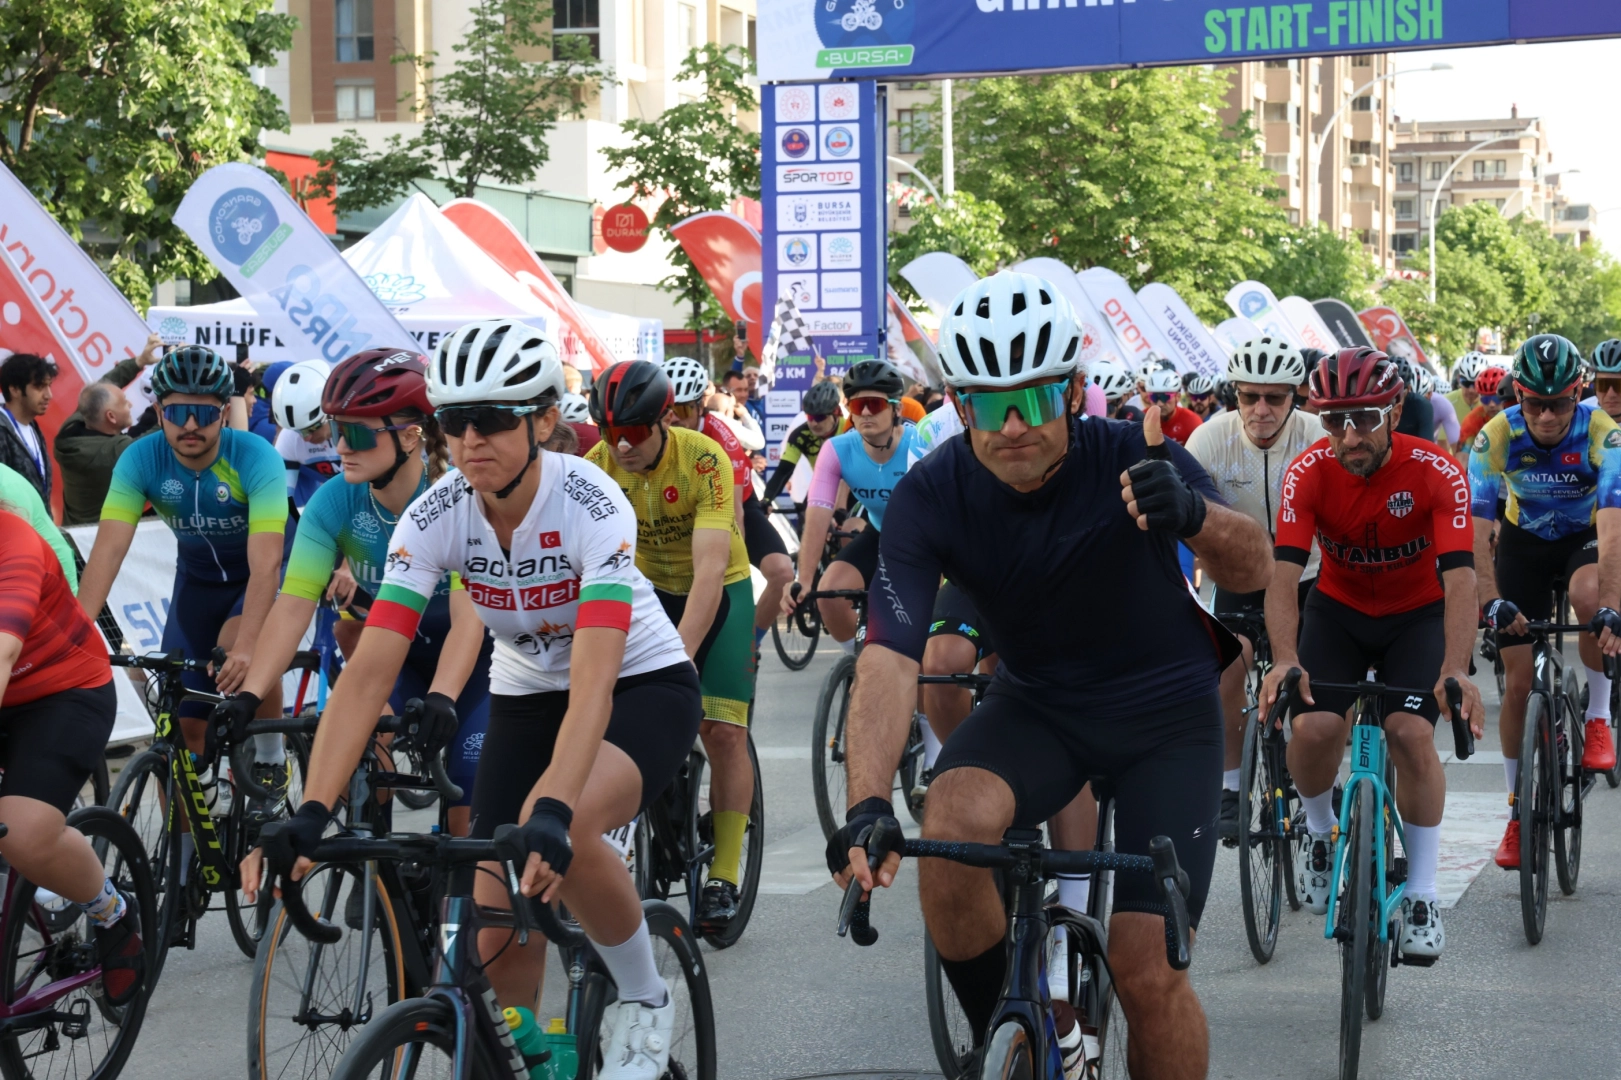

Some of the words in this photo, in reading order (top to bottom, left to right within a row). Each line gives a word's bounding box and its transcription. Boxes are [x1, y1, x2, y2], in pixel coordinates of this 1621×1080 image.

[1204, 0, 1443, 53] START-FINISH
[829, 50, 898, 65] BURSA
[373, 352, 412, 372] MET
[786, 367, 806, 379] KM
[567, 470, 619, 515] kadans
[1522, 473, 1579, 483] ANTALYA
[564, 481, 610, 522] bisiklet
[1358, 727, 1371, 769] BMC
[179, 748, 221, 849] SCOTT
